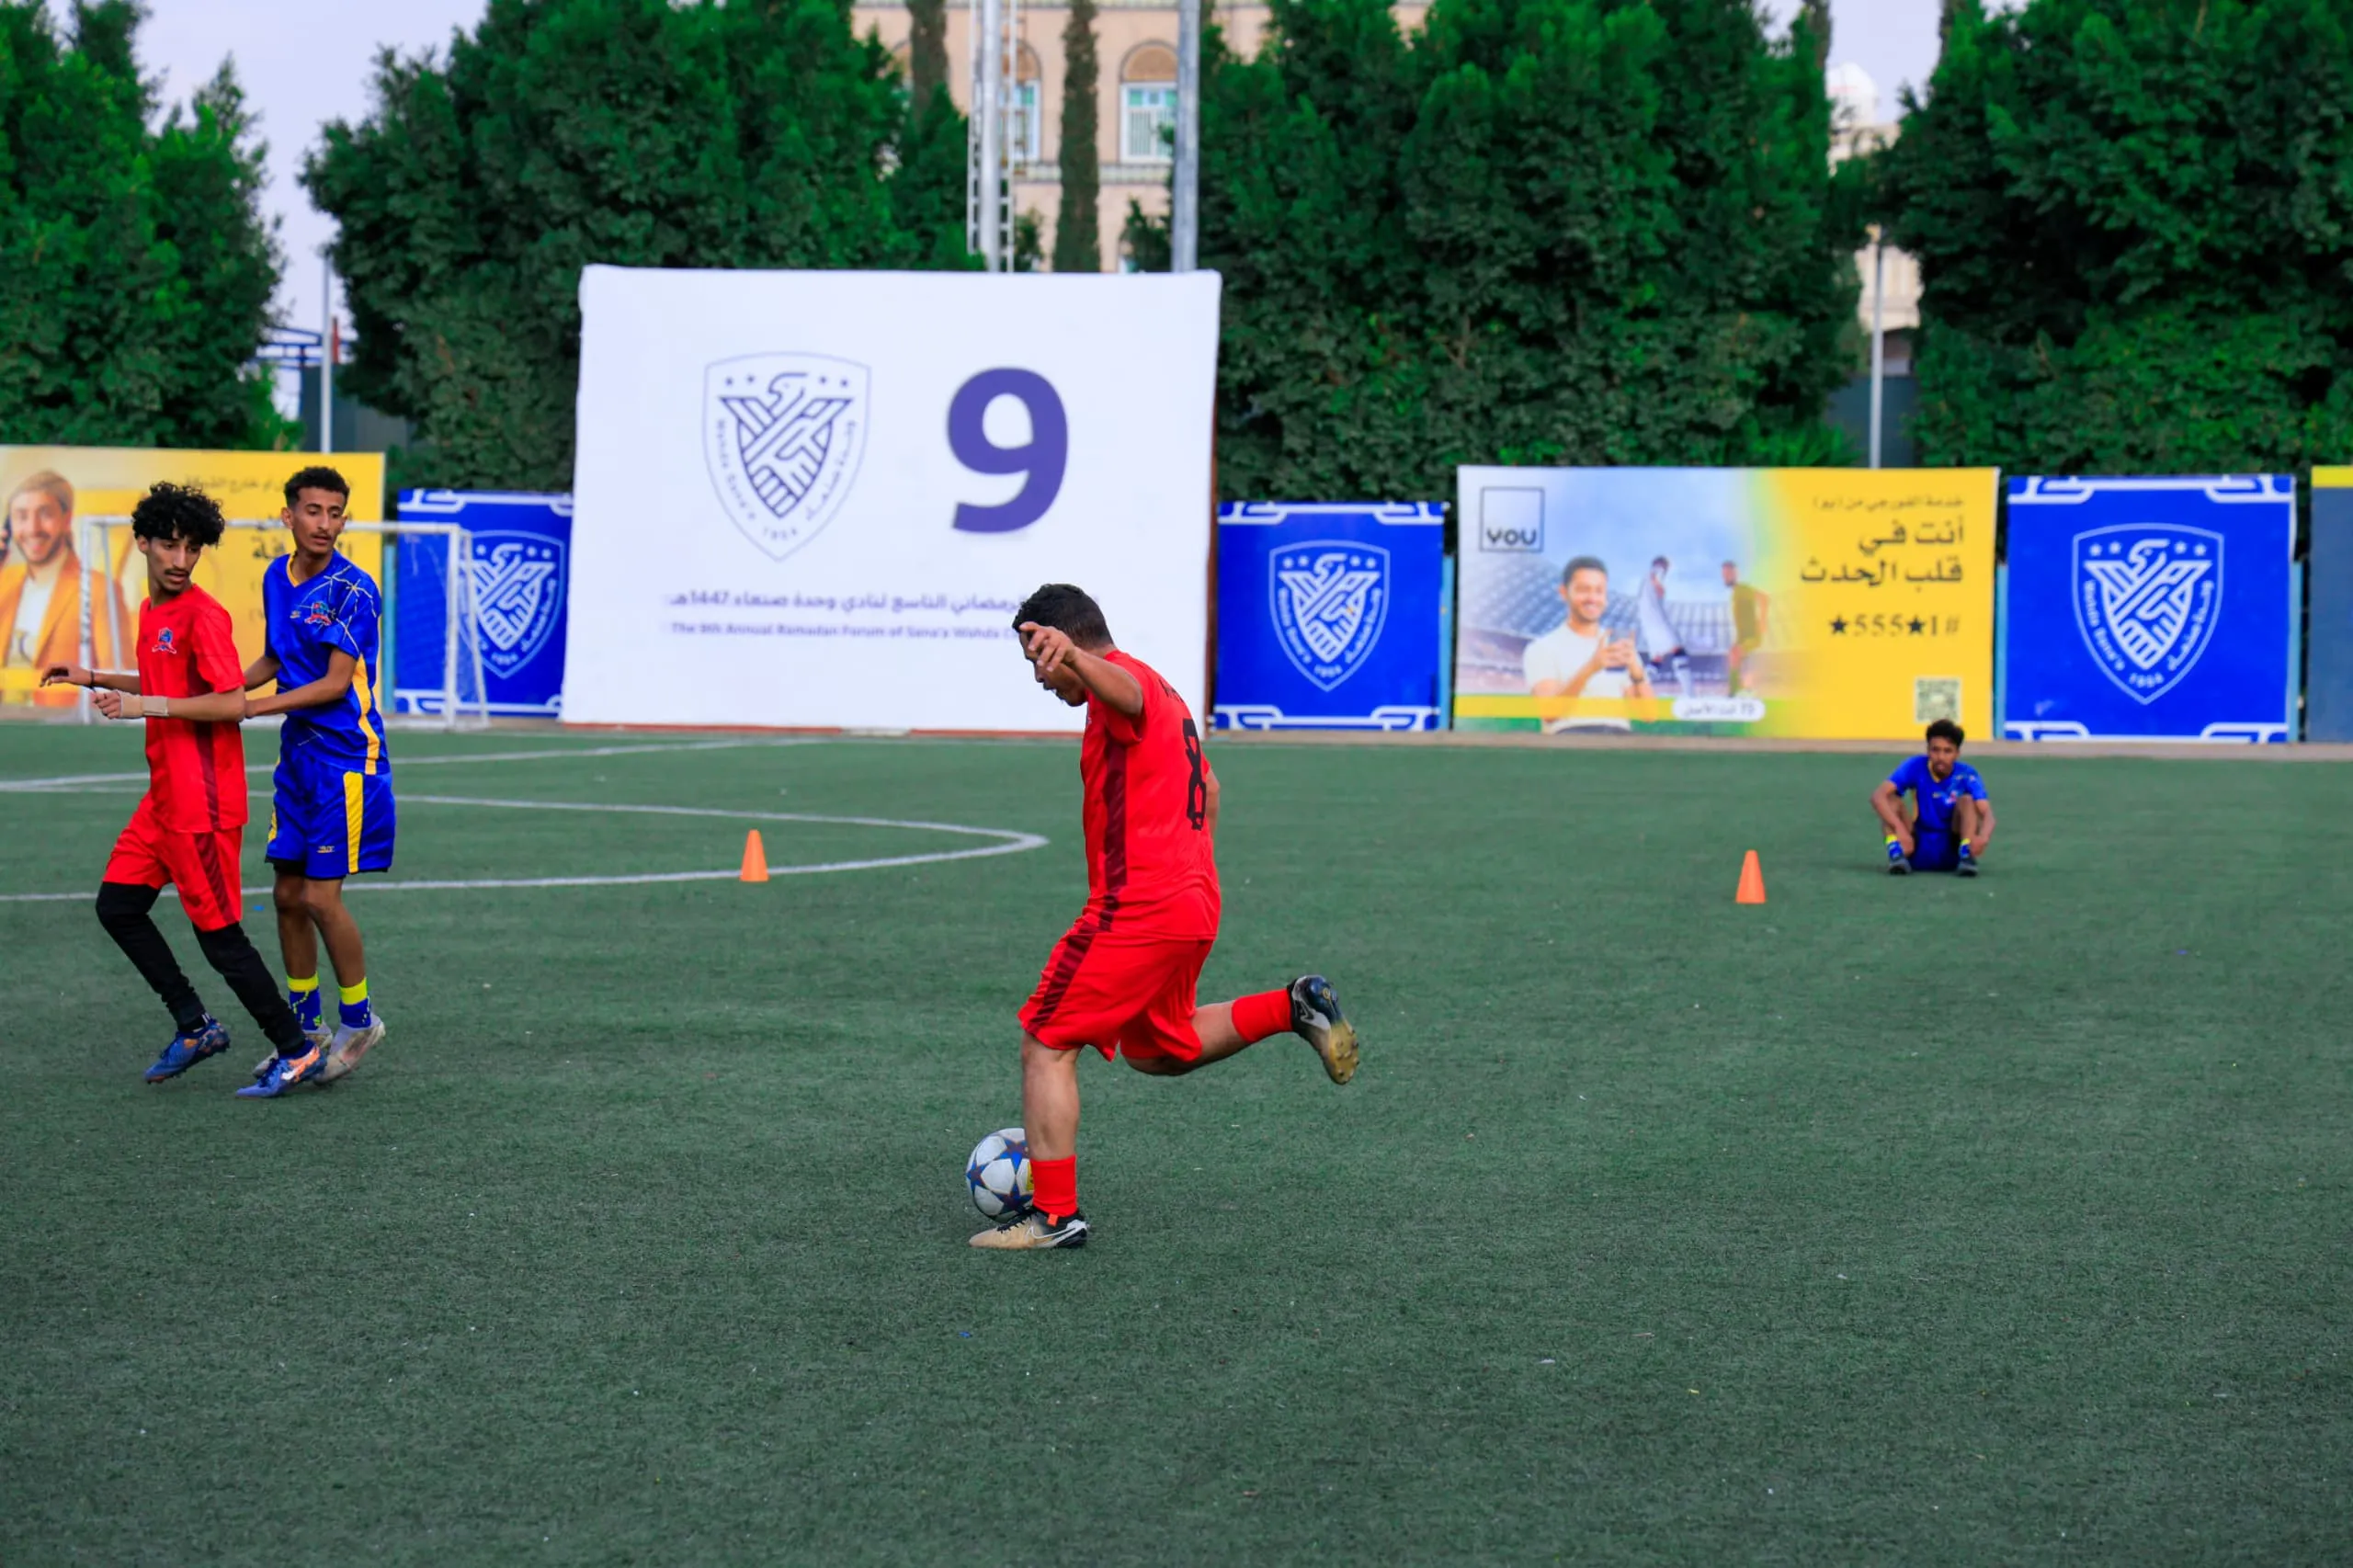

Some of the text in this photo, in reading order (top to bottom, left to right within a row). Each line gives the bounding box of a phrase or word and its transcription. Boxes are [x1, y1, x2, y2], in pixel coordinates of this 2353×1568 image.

[947, 366, 1069, 535] 9
[1859, 514, 1964, 556] أنت في
[1801, 554, 1963, 593] قلب الحدث
[892, 593, 948, 613] التاسع
[1183, 718, 1207, 831] 8
